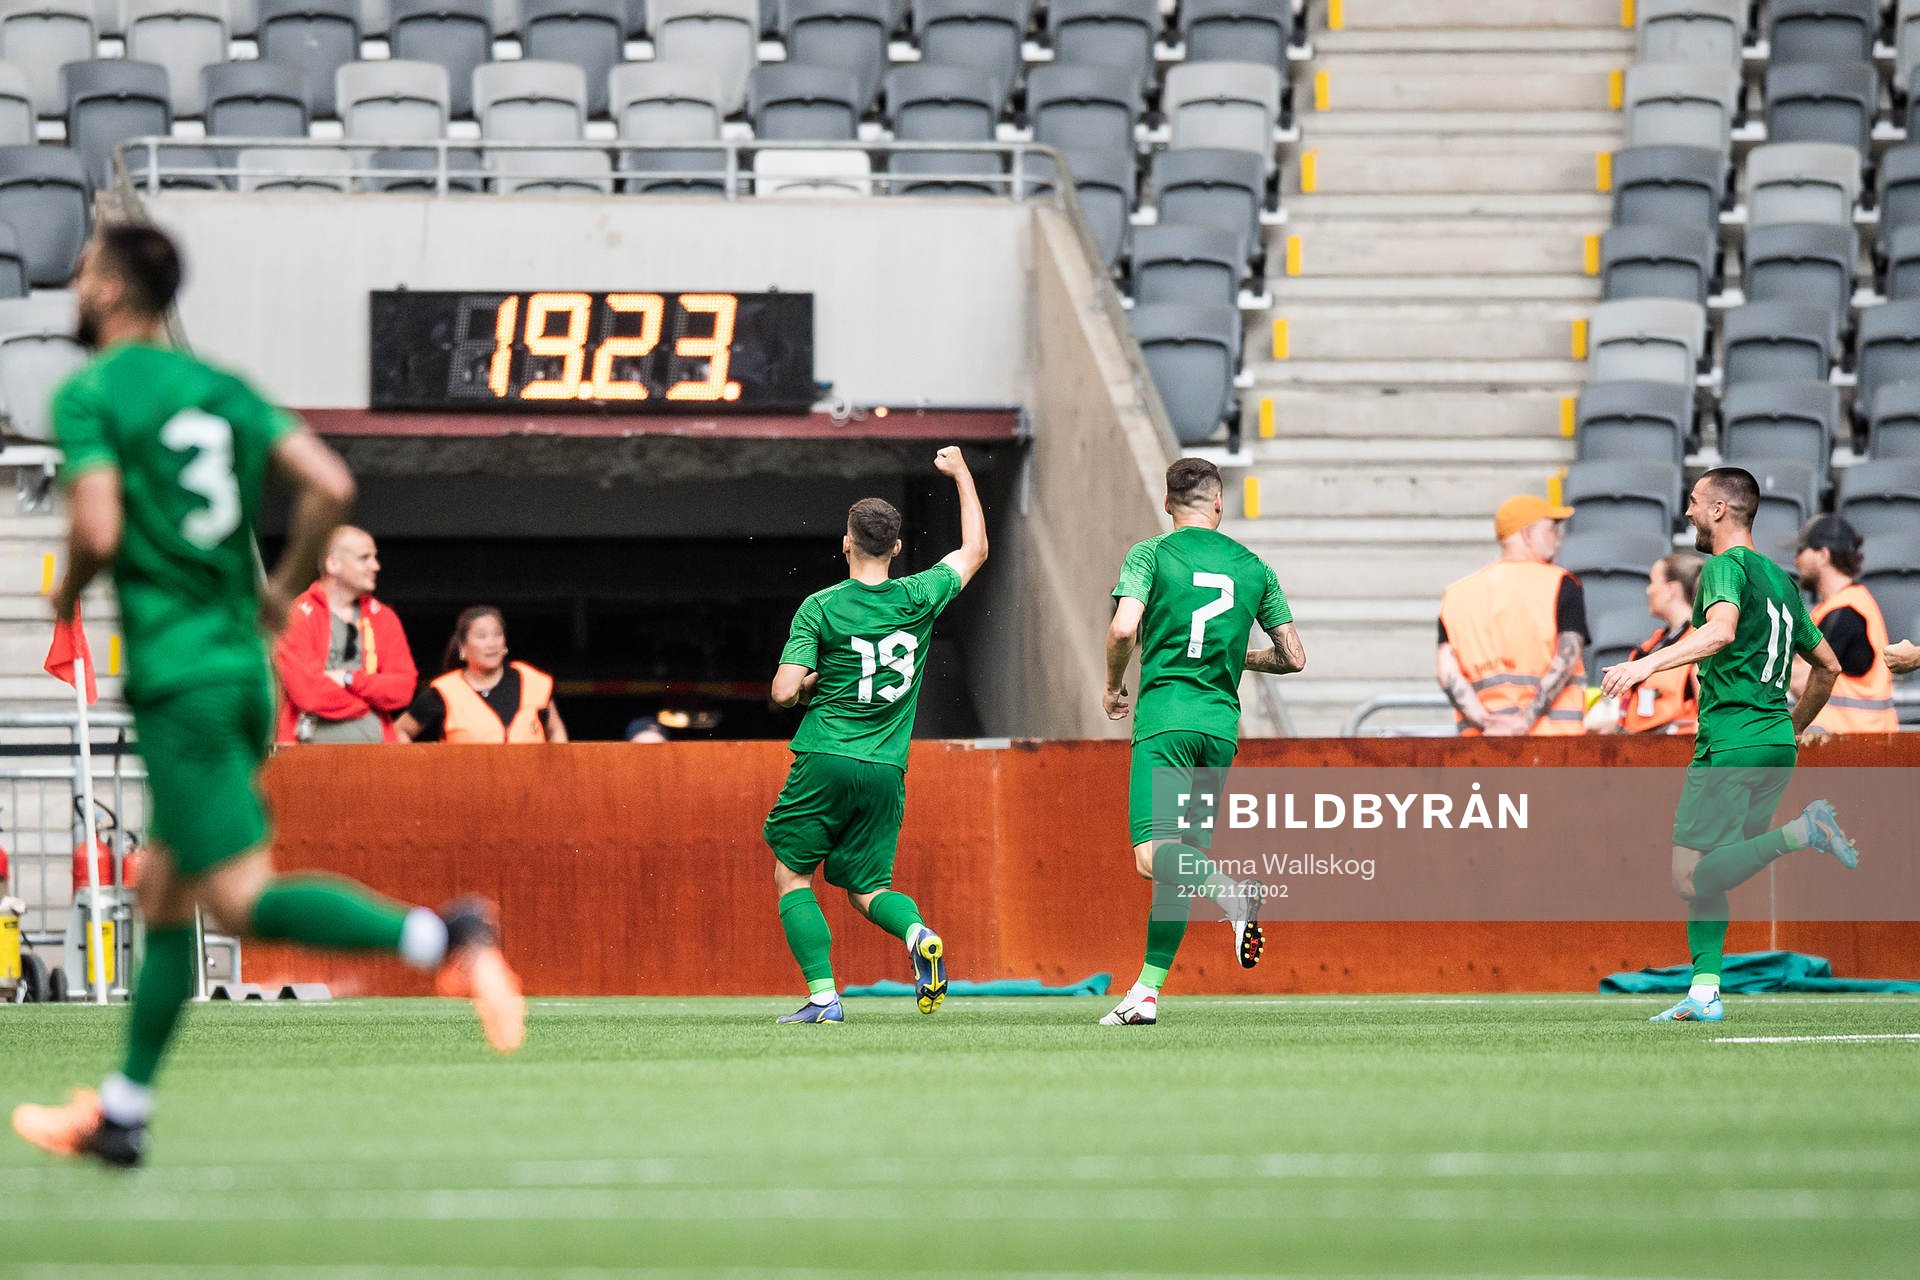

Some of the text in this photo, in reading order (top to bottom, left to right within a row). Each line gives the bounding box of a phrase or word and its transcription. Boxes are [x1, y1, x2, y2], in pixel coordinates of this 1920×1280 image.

[160, 410, 241, 548] 3
[1186, 572, 1235, 659] 7
[1761, 597, 1794, 690] 11
[850, 630, 919, 704] 19
